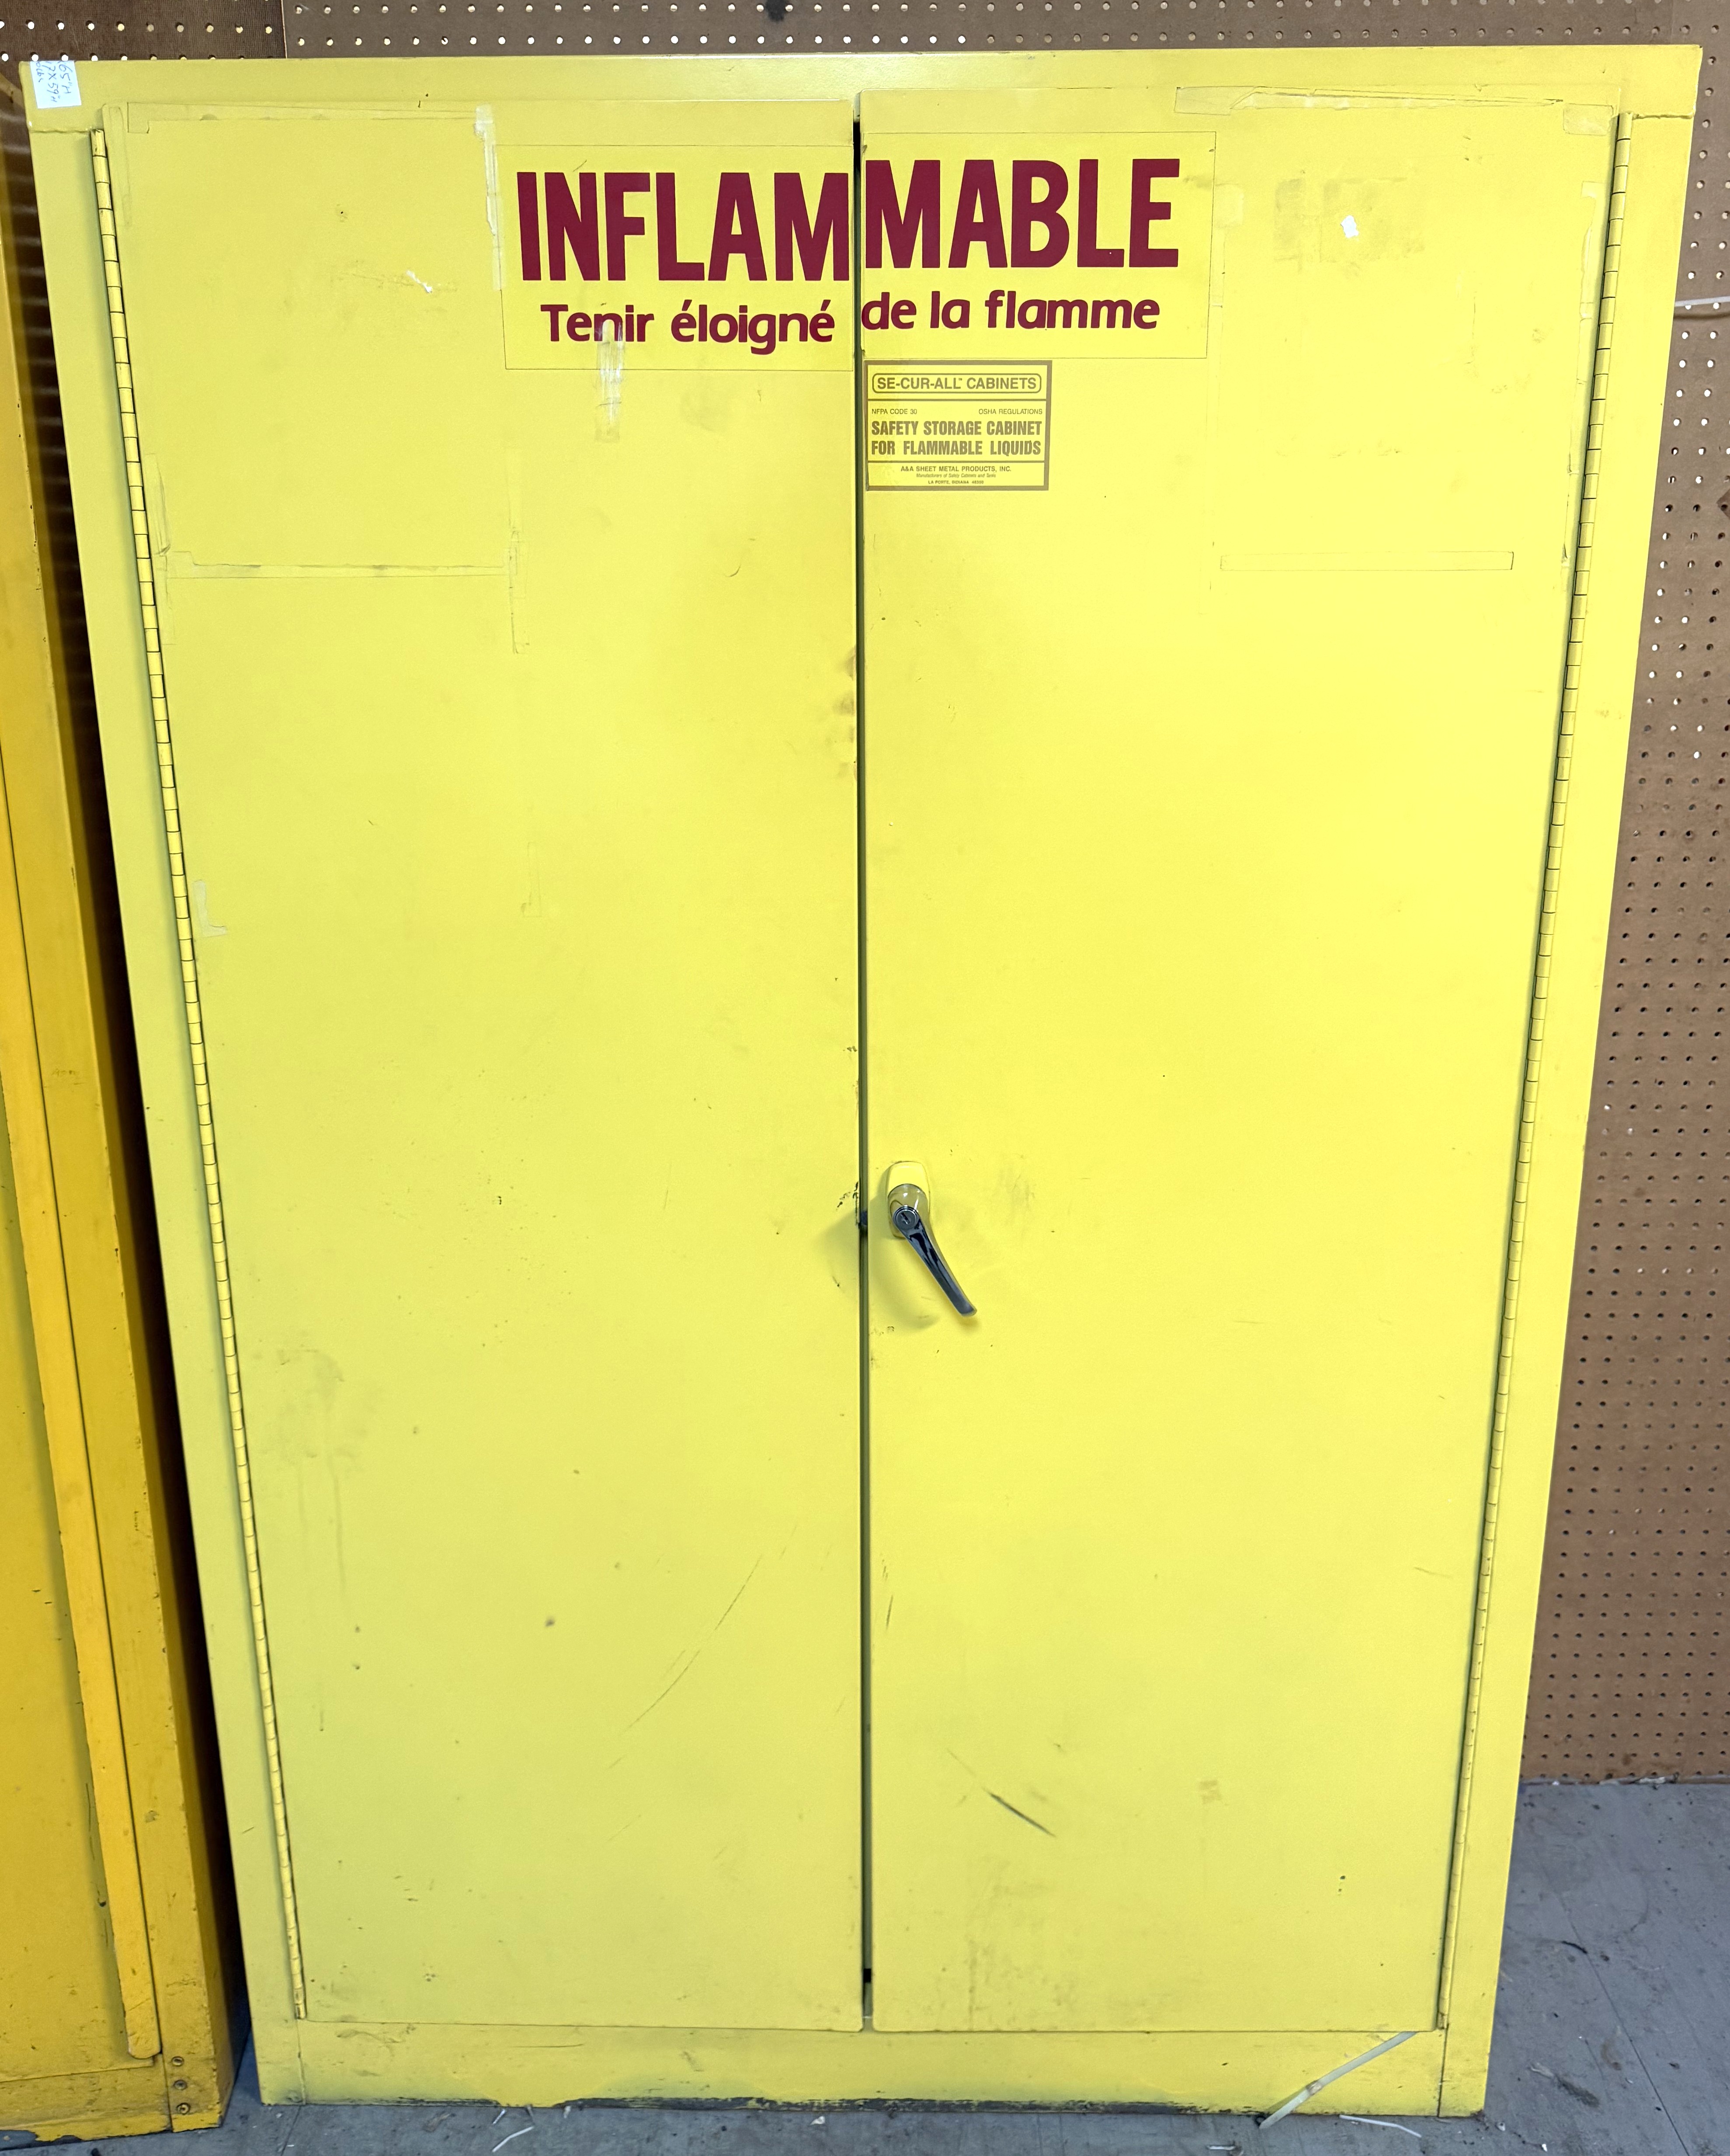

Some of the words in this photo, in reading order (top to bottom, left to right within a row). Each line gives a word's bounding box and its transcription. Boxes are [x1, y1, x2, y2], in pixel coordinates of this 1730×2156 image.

[540, 304, 654, 342] Tenir
[671, 299, 835, 355] éloigné
[862, 291, 917, 329] de
[930, 291, 970, 329] la
[985, 290, 1160, 329] flamme
[967, 377, 1036, 389] CABINETS
[872, 421, 918, 435] SAFETY
[924, 421, 982, 435] STORAGE
[987, 421, 1042, 435] CABINET
[872, 440, 895, 455] FOR
[903, 440, 983, 455] FLAMMABLE
[990, 440, 1041, 456] LIQUIDS
